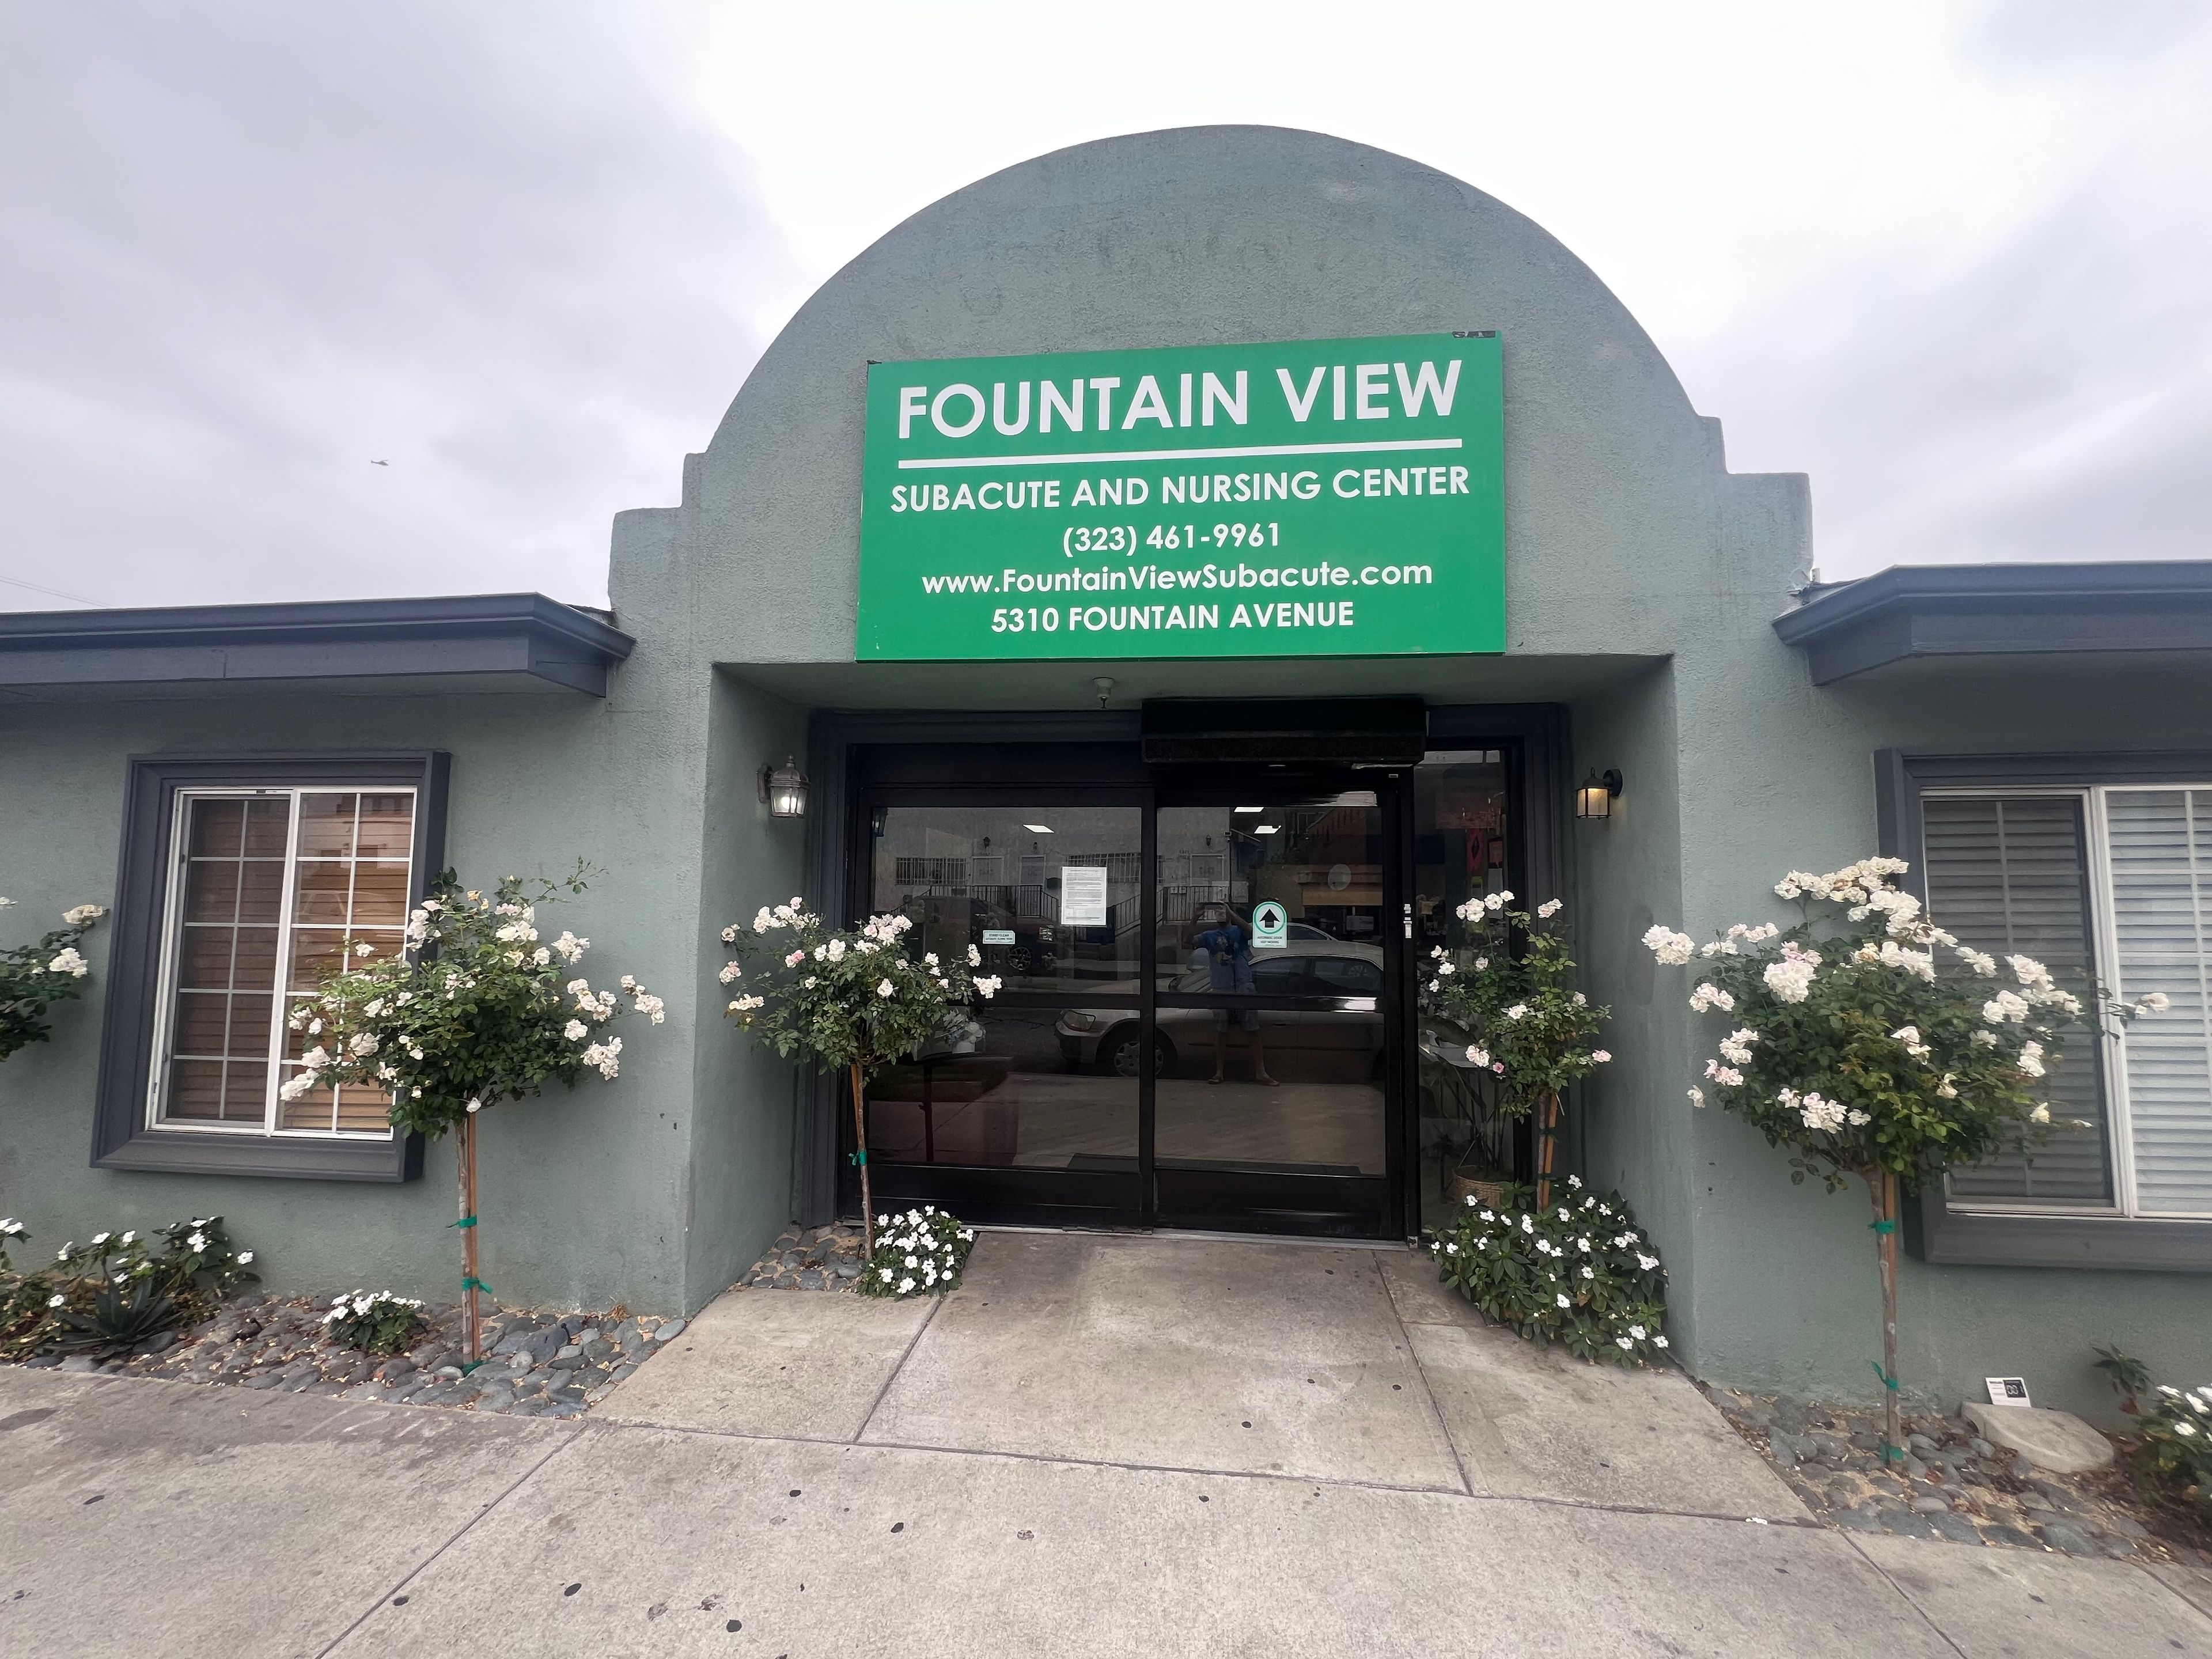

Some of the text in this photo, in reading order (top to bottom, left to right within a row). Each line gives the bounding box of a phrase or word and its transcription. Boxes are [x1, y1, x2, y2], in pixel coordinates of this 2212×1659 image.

[898, 358, 1463, 439] FOUNTAIN VIEW
[890, 465, 1470, 513] SUBACUTE AND NURSING CENTER
[1063, 522, 1279, 558] (323) 461-9961
[921, 561, 1433, 594] www.FountainViewSubacute.com
[991, 601, 1354, 632] 5310 FOUNTAIN AVENUE
